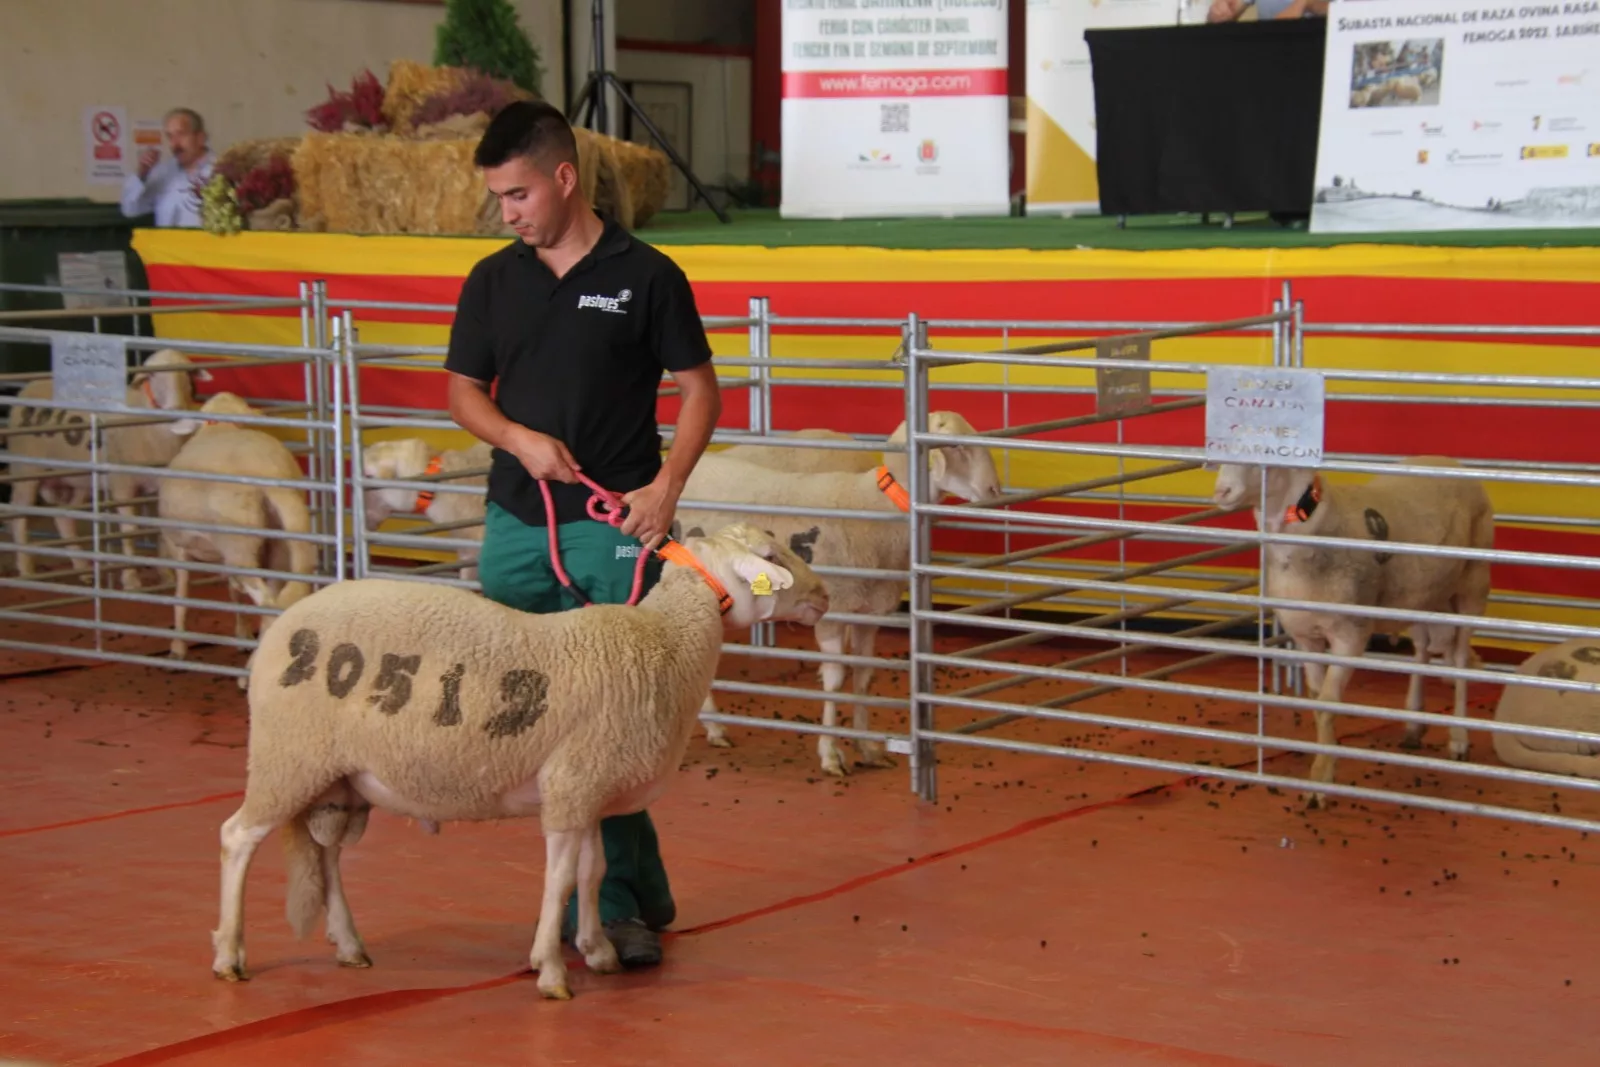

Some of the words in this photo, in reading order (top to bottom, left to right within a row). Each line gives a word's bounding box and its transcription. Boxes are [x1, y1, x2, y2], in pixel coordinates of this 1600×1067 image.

[1338, 17, 1392, 31] SUBASTA
[1397, 13, 1458, 27] NACIONAL
[1462, 10, 1478, 23] DE
[1481, 8, 1515, 21] RAZA
[1518, 5, 1559, 18] OVINA
[1563, 1, 1599, 14] RASA
[1463, 28, 1516, 43] FEMOGA
[820, 74, 972, 94] www.femoga.com
[578, 294, 619, 309] pastores
[615, 543, 641, 560] pasto
